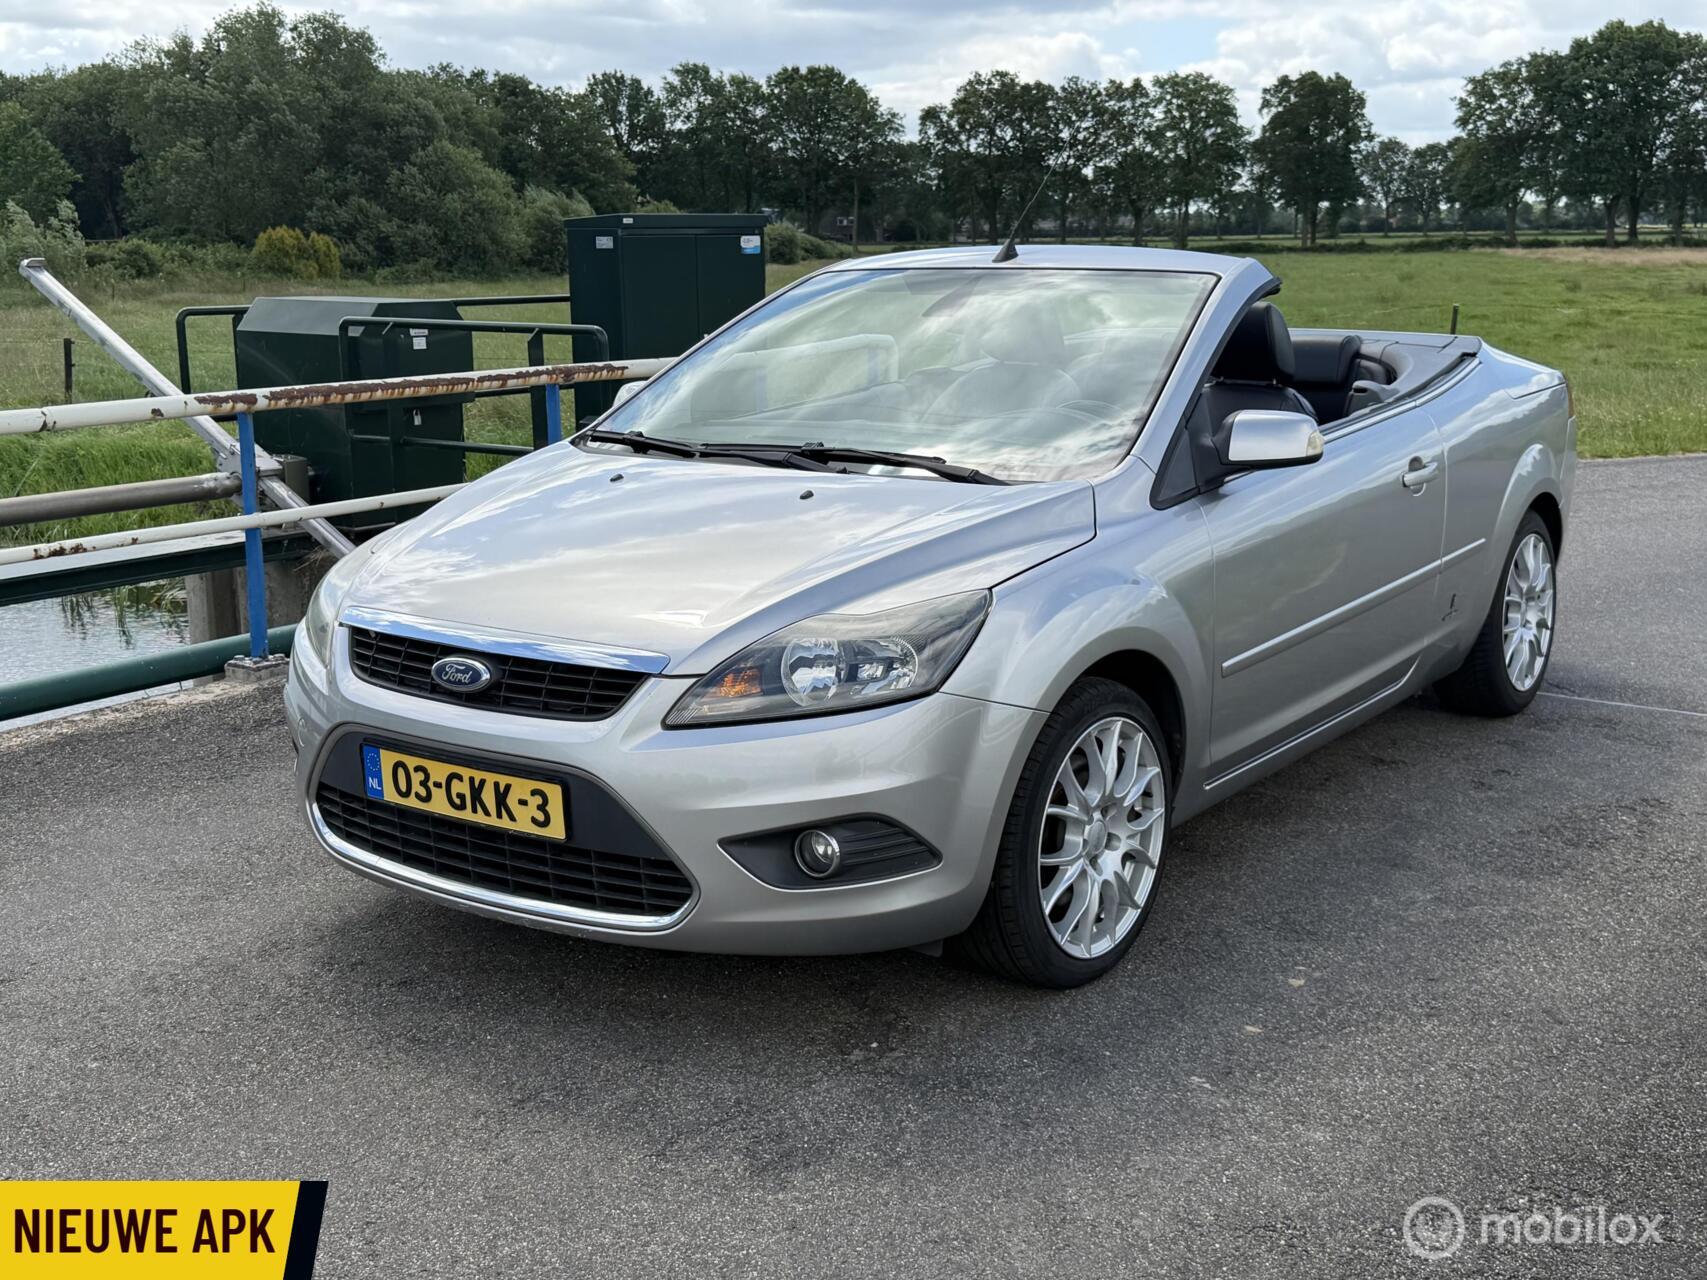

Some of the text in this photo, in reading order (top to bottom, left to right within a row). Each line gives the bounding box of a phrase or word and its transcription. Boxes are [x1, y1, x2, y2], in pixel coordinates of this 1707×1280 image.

[441, 663, 473, 684] Ford
[368, 776, 382, 791] NL
[391, 760, 551, 828] 03-GKK-3
